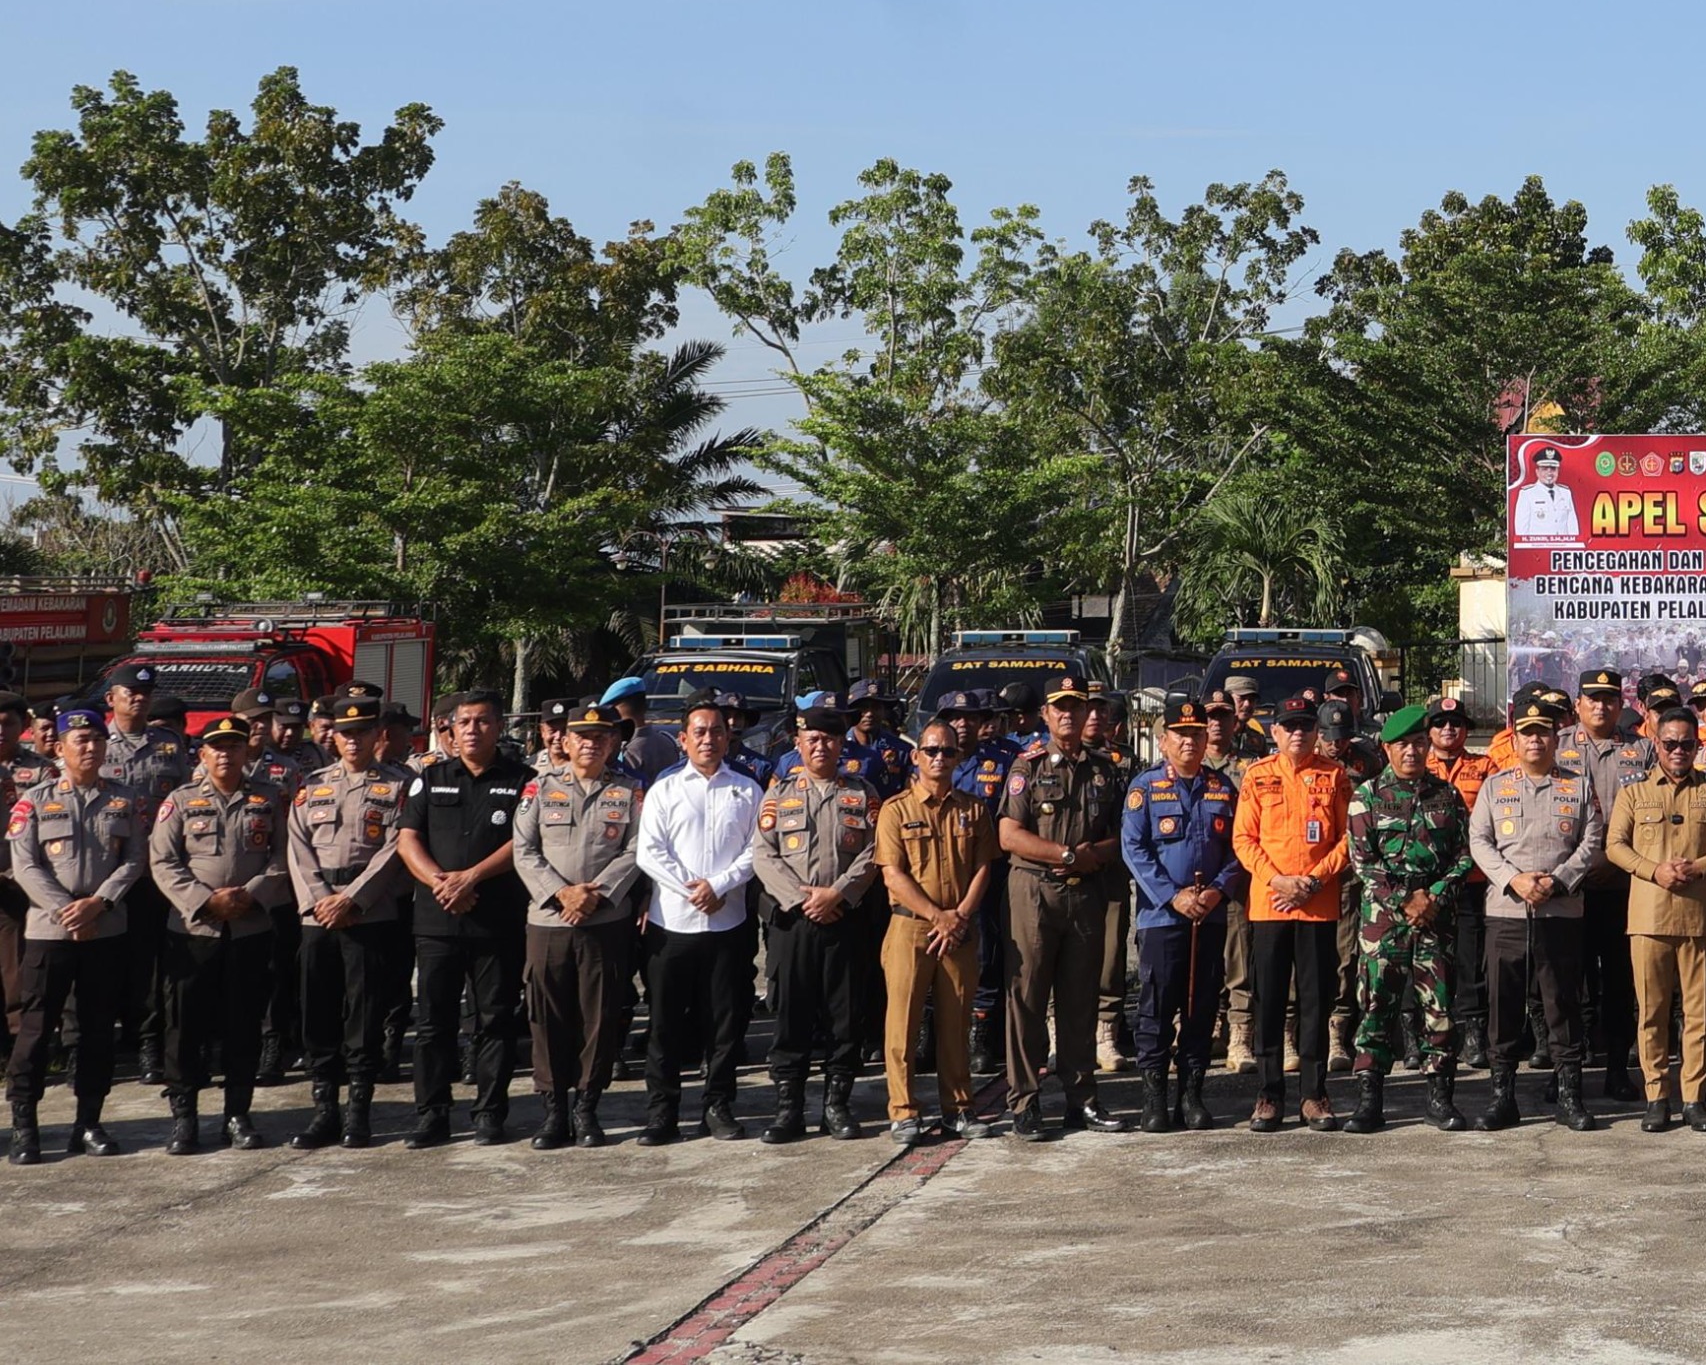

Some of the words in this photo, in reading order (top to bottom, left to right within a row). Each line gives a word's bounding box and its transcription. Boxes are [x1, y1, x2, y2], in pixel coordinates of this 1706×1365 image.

[1591, 491, 1686, 535] APEL
[1551, 551, 1663, 570] PENCEGAHAN
[1669, 551, 1703, 570] DAN
[1535, 576, 1614, 595] BENCANA
[38, 596, 87, 611] KEBAKARAN
[1554, 600, 1650, 619] KABUPATEN
[0, 626, 39, 642] ABUPATEN
[40, 625, 87, 639] PELALAWAN
[950, 661, 984, 670] SAT
[987, 660, 1067, 670] SAMAPTA
[1230, 660, 1262, 668] SAT
[1266, 659, 1343, 668] SAMAPTA
[656, 664, 690, 674] SAT
[693, 664, 775, 674] SABHARA
[489, 787, 517, 795] POLRI
[1151, 793, 1177, 801] INDRA
[1553, 796, 1579, 804] POLRI
[601, 800, 628, 808] POLRI
